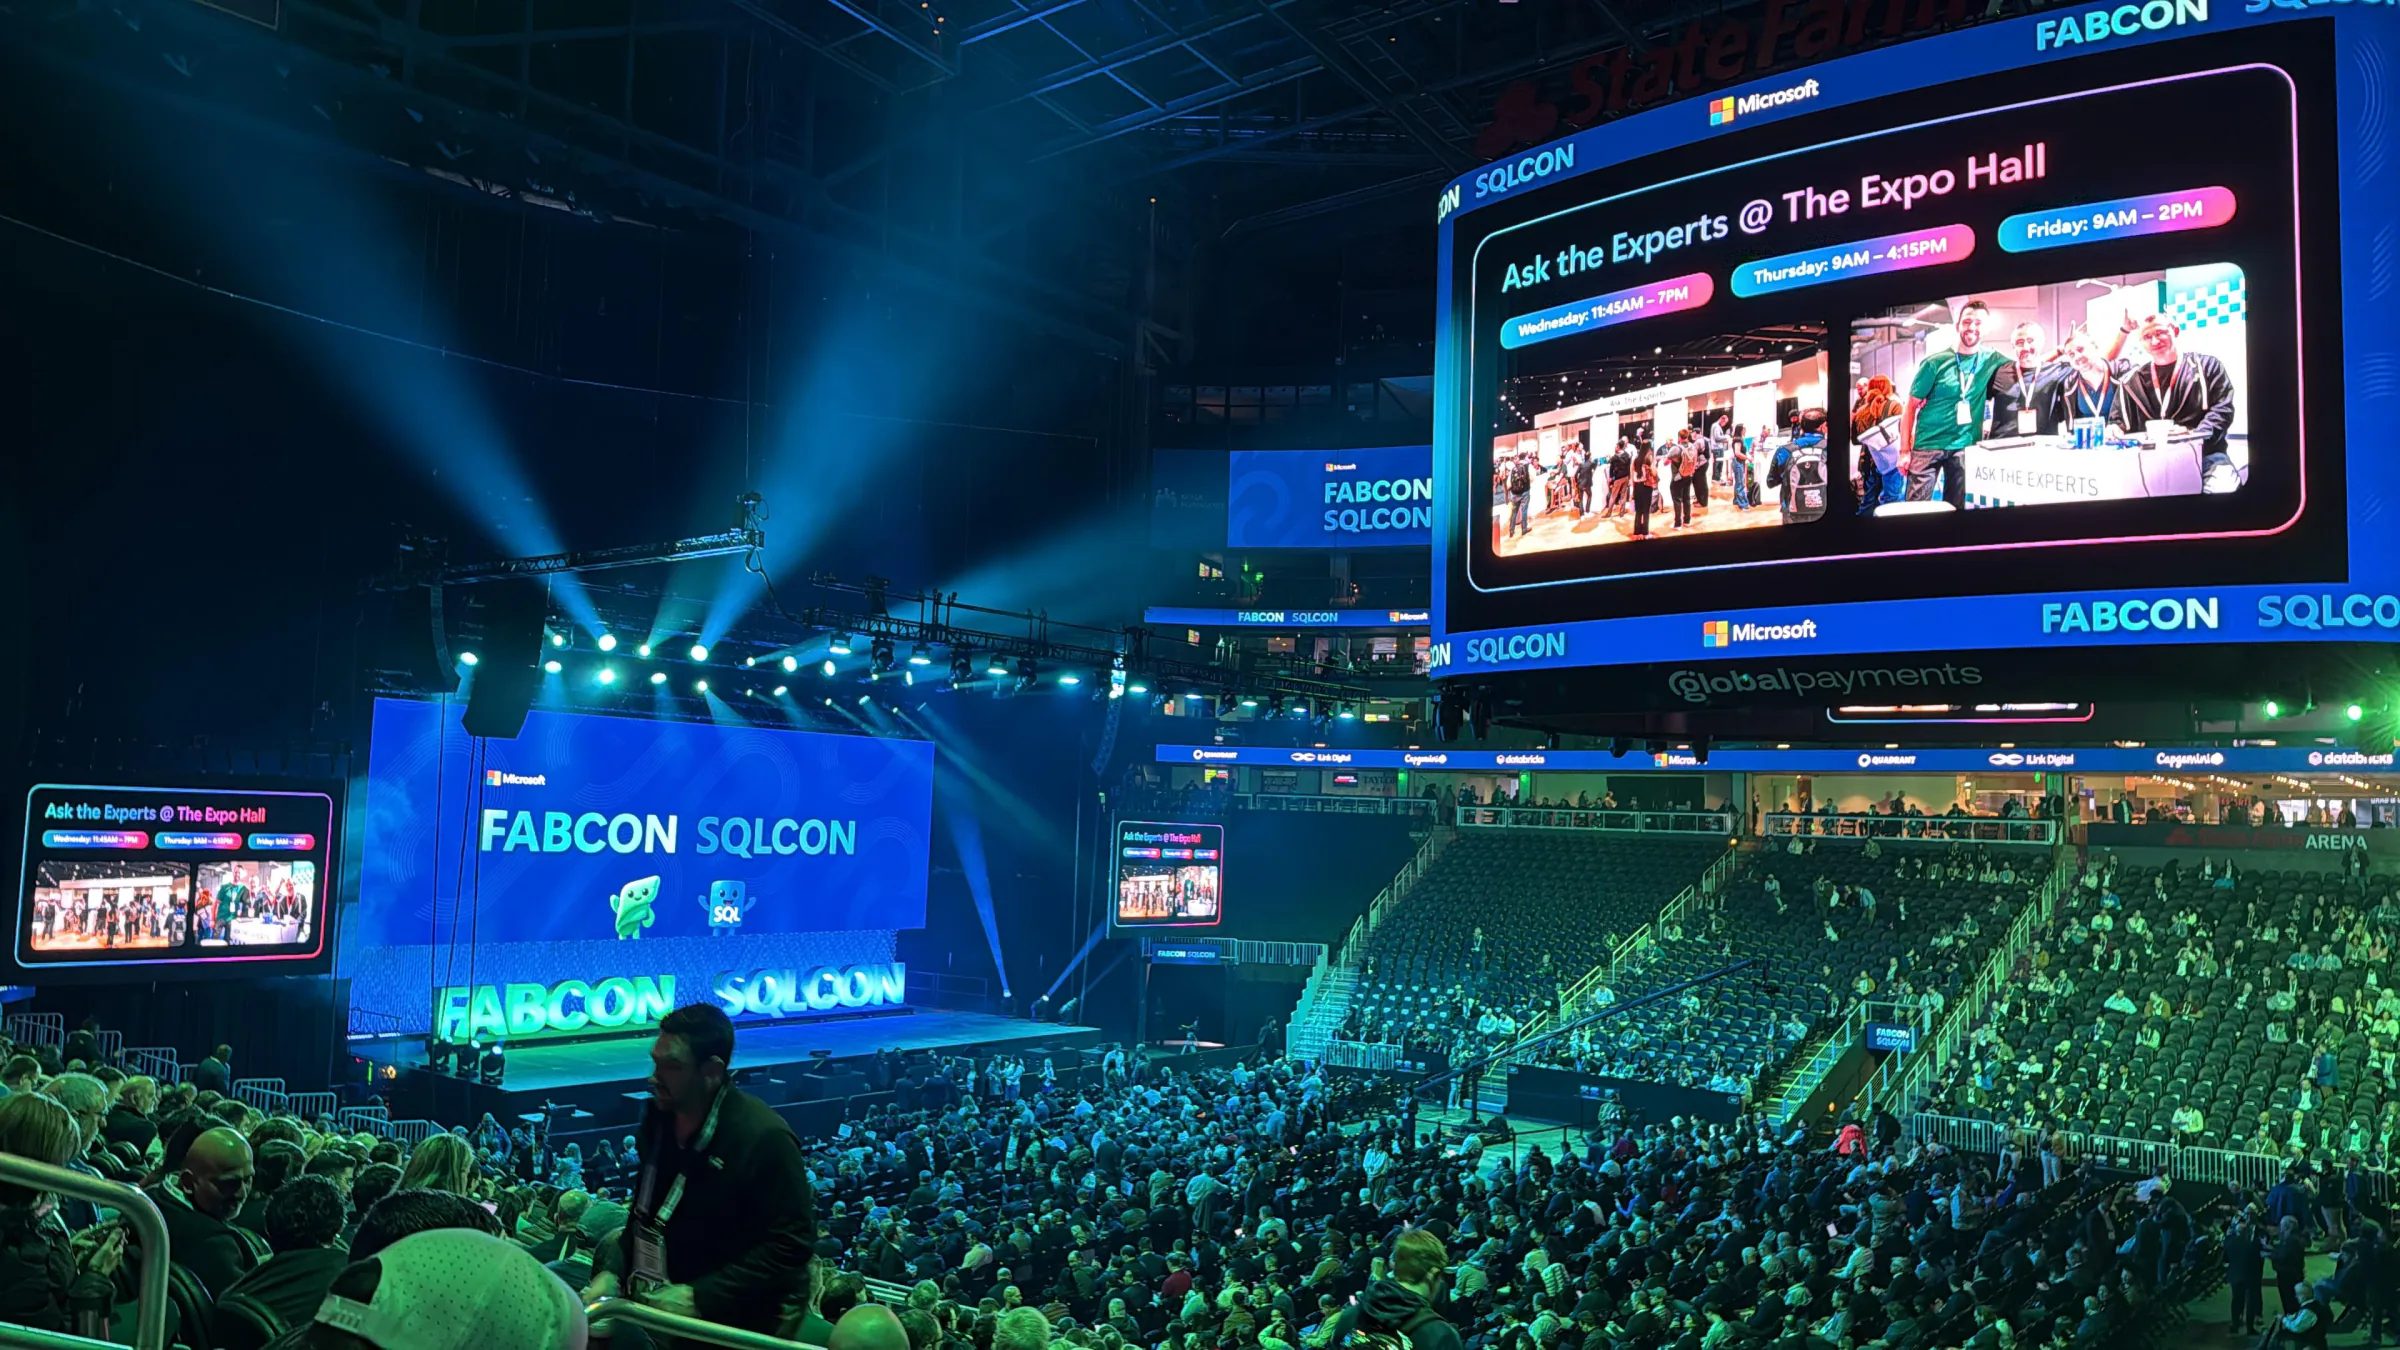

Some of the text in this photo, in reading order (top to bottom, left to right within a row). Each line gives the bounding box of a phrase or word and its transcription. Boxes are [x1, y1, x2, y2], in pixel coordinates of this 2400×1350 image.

[2036, 0, 2208, 51] FABCON
[1737, 78, 1820, 116] Microsoft
[1475, 143, 1575, 198] SQLCON
[1501, 142, 2046, 293] Ask the Experts @ The Expo Hall
[2027, 217, 2088, 239] Friday:
[2092, 208, 2137, 230] 9AM
[2158, 200, 2203, 221] 2PM
[1754, 260, 1829, 285] Thursday:
[1831, 250, 1870, 271] 9AM
[1886, 237, 1948, 261] 4:15PM
[1518, 310, 1590, 337] Wednesday:
[1591, 296, 1644, 320] 11:45AM
[1657, 285, 1689, 304] 7PM
[1324, 478, 1433, 504] FABCON
[1974, 465, 2099, 498] ASK THE EXPERTS
[1323, 506, 1432, 533] SQLCON
[1238, 612, 1338, 624] FABCON SQLCON
[1400, 612, 1429, 621] Microsoft
[2043, 594, 2400, 634] FABCON SQLCO
[1733, 619, 1817, 642] Microsoft
[1467, 632, 1565, 663] SQLCON
[1505, 754, 1545, 764] databricks
[1668, 755, 1708, 765] Micros
[1872, 755, 1916, 765] QUADRANT
[2047, 754, 2074, 767] Digital
[2156, 752, 2211, 768] Capgemini
[503, 773, 546, 786] Microsoft
[45, 802, 267, 826] Ask the Experts @ The Expo Hall
[481, 809, 856, 859] FABCON SQLCON
[2305, 834, 2368, 850] ARENA
[713, 905, 741, 924] SQL
[434, 961, 906, 1039] FABCON SQLCON
